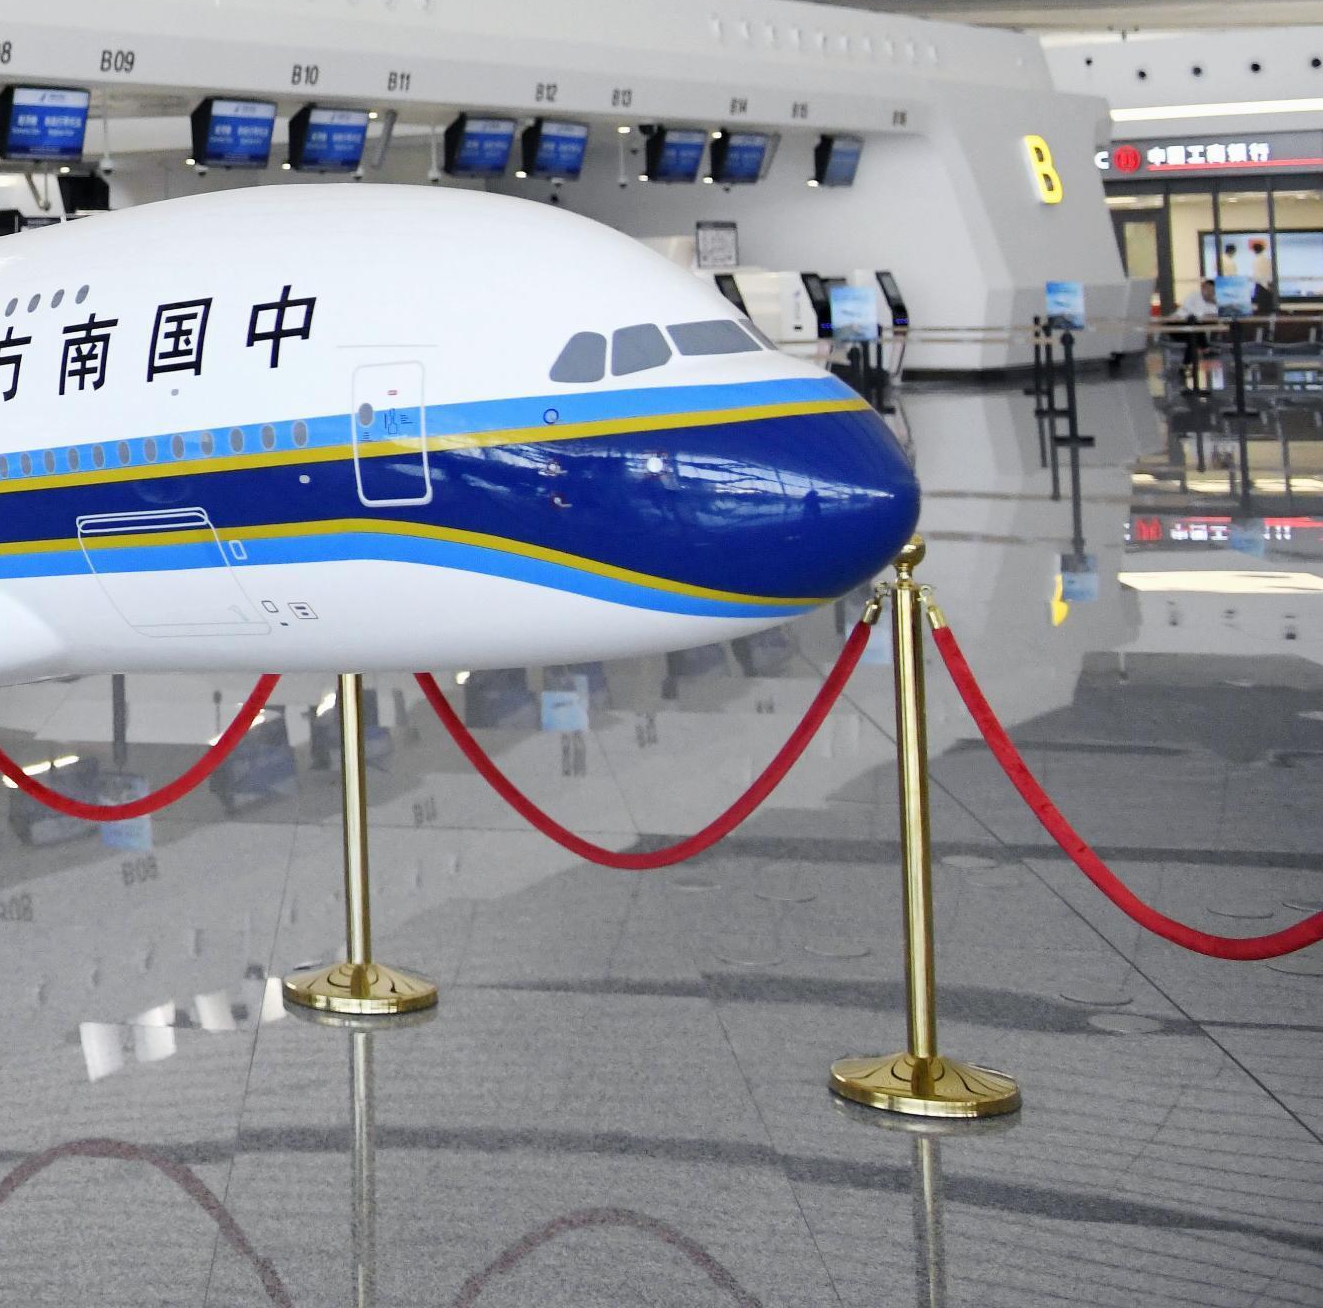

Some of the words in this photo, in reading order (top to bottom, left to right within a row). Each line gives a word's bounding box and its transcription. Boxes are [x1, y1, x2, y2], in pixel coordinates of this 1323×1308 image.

[100, 50, 135, 73] B09
[291, 64, 318, 85] B10
[388, 71, 411, 91] B11
[1023, 134, 1063, 204] B
